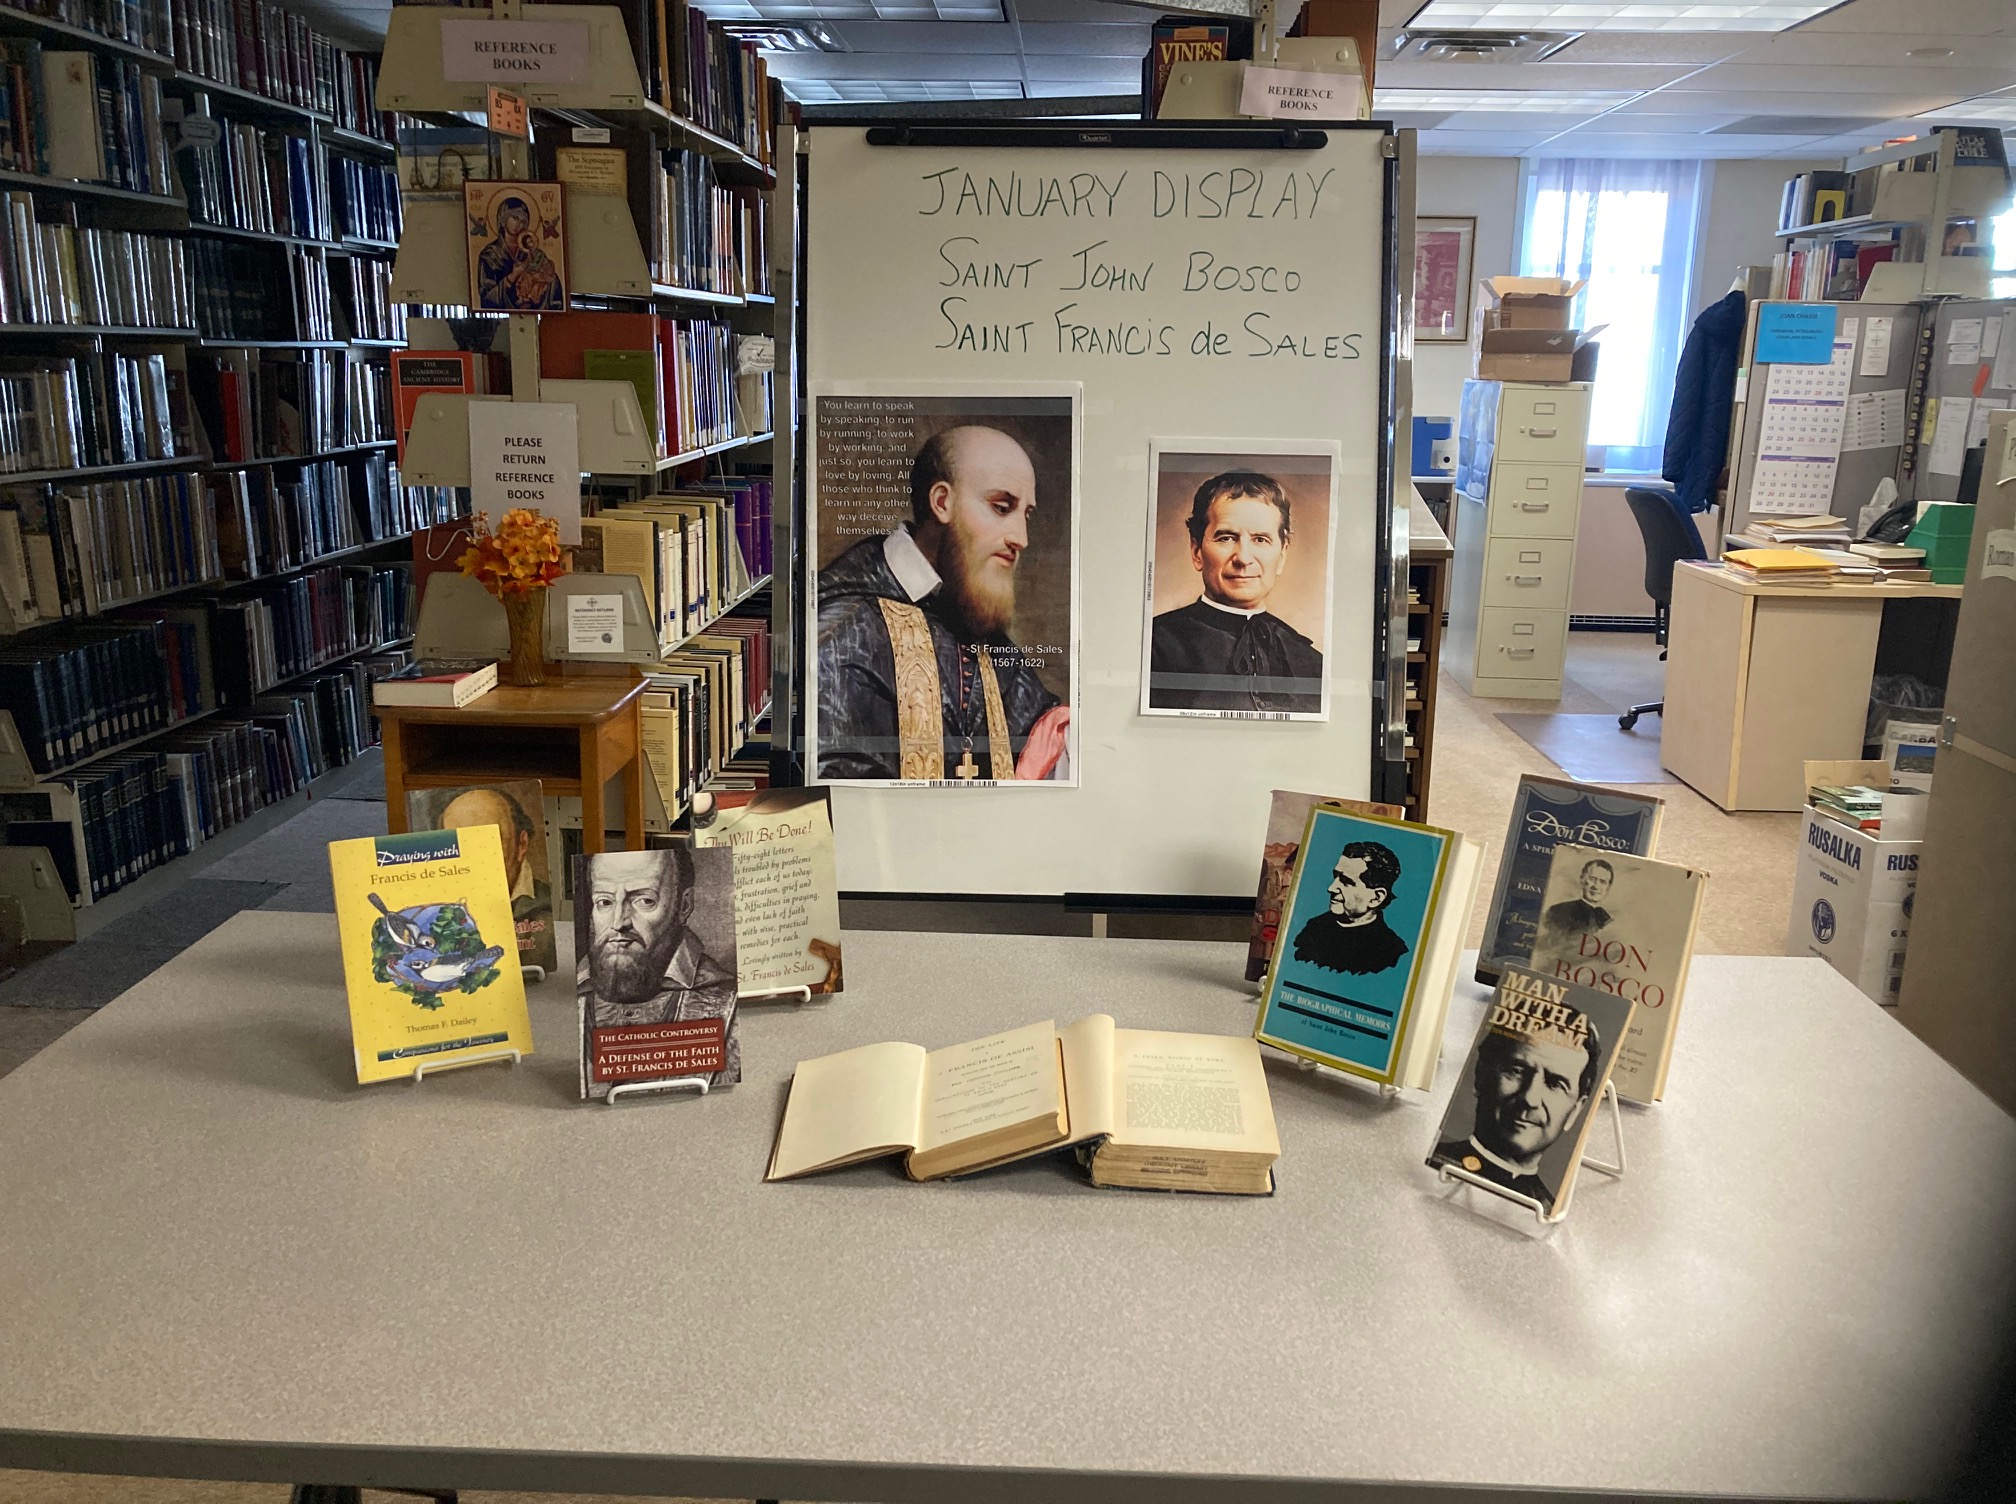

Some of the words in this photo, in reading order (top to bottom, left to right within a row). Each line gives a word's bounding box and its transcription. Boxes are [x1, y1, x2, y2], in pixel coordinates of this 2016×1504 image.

[474, 40, 557, 55] REFERENCE
[1160, 41, 1222, 64] VINE'S
[492, 58, 541, 71] BOOKS
[1268, 84, 1334, 100] REFERENCE
[1280, 100, 1318, 111] BOOKS
[918, 167, 1128, 218] JANUARY
[1153, 168, 1335, 220] DISPLAY
[939, 237, 1042, 289] SAINT
[1059, 240, 1153, 291] JOHN
[1183, 251, 1301, 293] BOSCO
[935, 296, 1034, 353] SAINT
[1191, 320, 1231, 355] de
[1244, 312, 1362, 359] SALES
[844, 401, 869, 410] learn
[872, 401, 882, 410] to
[885, 401, 915, 411] speak
[820, 414, 832, 425] by
[885, 415, 895, 423] to
[820, 429, 831, 438] by
[877, 430, 887, 438] to
[890, 429, 915, 438] work
[504, 437, 543, 447] PLEASE
[828, 443, 840, 453] by
[888, 443, 907, 452] and
[503, 454, 546, 464] RETURN
[818, 457, 837, 468] just
[857, 458, 875, 468] you
[877, 457, 902, 466] learn
[905, 457, 915, 466] to
[495, 473, 554, 483] REFERENCE
[825, 471, 845, 479] love
[848, 471, 860, 481] by
[863, 471, 895, 482] loving.
[897, 471, 910, 479] All
[507, 490, 545, 499] BOOKS
[822, 485, 849, 493] those
[852, 485, 873, 493] who
[876, 485, 900, 493] think
[903, 485, 913, 493] to
[825, 499, 850, 507] learn
[852, 499, 860, 507] in
[864, 500, 881, 509] any
[884, 499, 910, 507] other
[837, 514, 857, 522] way
[860, 513, 898, 521] deceive
[983, 644, 1019, 654] Francis
[1021, 644, 1034, 654] de
[1036, 644, 1063, 654] Sales
[989, 658, 1045, 668] (1567-1622)
[729, 830, 754, 846] Will
[756, 828, 774, 844] Be
[776, 820, 812, 839] Done!
[1526, 810, 1575, 840] Don
[1575, 820, 1631, 850] Bosco:
[772, 846, 794, 856] letters
[1808, 822, 1862, 871] RUSALKA
[377, 850, 430, 867] Praying
[433, 844, 459, 858] with
[742, 862, 769, 873] troubled
[771, 860, 780, 869] by
[782, 855, 811, 869] problems
[370, 870, 416, 885] Francis
[420, 868, 436, 879] de
[438, 865, 471, 877] Sales
[756, 873, 771, 883] each
[774, 871, 781, 882] of
[1819, 869, 1839, 887] VODKA
[741, 886, 780, 901] frustration,
[782, 881, 798, 894] grief
[799, 879, 811, 888] and
[1518, 882, 1542, 894] EDNA
[745, 898, 781, 912] difficulties
[762, 910, 777, 920] lack
[779, 908, 786, 919] of
[788, 905, 805, 918] faith
[514, 919, 545, 933] ales
[742, 926, 757, 936] with
[779, 916, 809, 933] practical
[740, 939, 769, 950] remedies
[771, 935, 781, 947] for
[783, 931, 800, 942] each.
[742, 954, 770, 966] Lovingly
[772, 951, 793, 960] written
[795, 947, 802, 957] by
[1577, 932, 1655, 974] DON
[751, 970, 781, 980] Francis
[783, 965, 791, 975] de
[793, 961, 815, 973] Sales
[1502, 970, 1569, 1005] MAN
[1554, 957, 1665, 1010] BOSCO
[1280, 991, 1295, 1002] THE
[1296, 996, 1352, 1019] BIOGRAPHICAL
[1355, 1013, 1391, 1030] MEMOIRS
[1500, 988, 1573, 1027] WITH
[1568, 1013, 1588, 1033] A
[405, 1024, 439, 1033] Thomas
[450, 1017, 477, 1027] Dailey
[1309, 1020, 1323, 1031] Saint
[1324, 1025, 1337, 1035] John
[1339, 1029, 1356, 1040] Bosco
[1488, 1006, 1588, 1053] DREAM
[599, 1034, 615, 1043] THE
[617, 1031, 658, 1041] CATHOLIC
[661, 1026, 718, 1038] CONTROVERSY
[440, 1043, 451, 1052] for
[452, 1041, 463, 1049] the
[598, 1056, 606, 1064] A
[609, 1052, 650, 1064] DEFENSE
[653, 1051, 667, 1059] OF
[669, 1049, 689, 1058] THE
[691, 1046, 719, 1056] FAITH
[602, 1067, 613, 1075] BY
[616, 1065, 630, 1074] ST.
[632, 1061, 673, 1073] FRANCIS
[676, 1060, 689, 1068] DE
[691, 1057, 718, 1067] SALES
